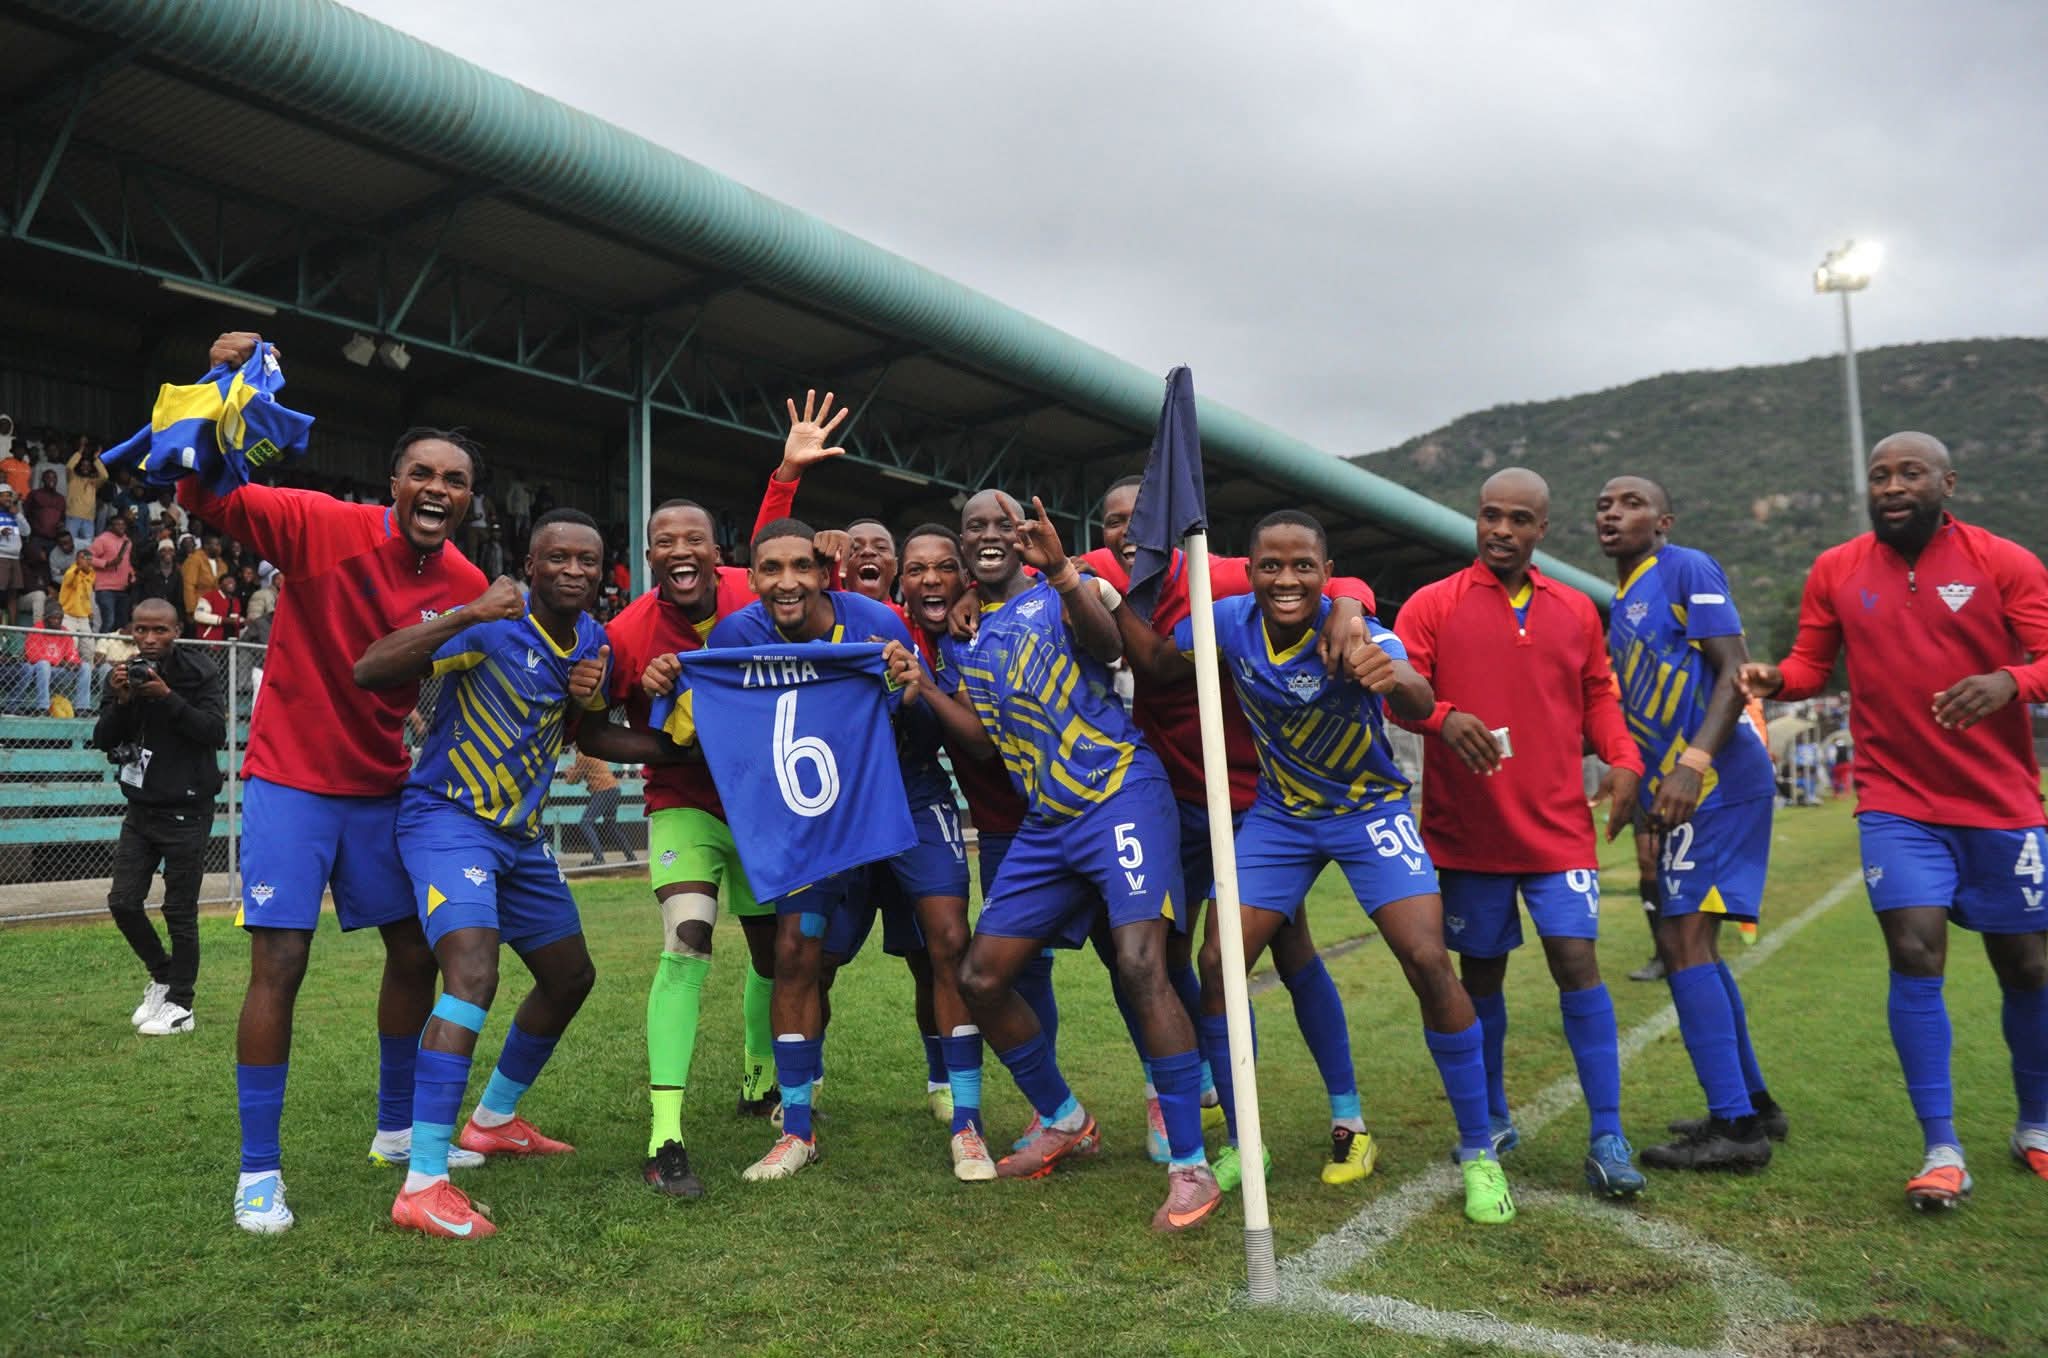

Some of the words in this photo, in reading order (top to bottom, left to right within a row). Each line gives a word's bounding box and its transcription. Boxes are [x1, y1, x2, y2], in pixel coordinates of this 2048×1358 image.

[739, 661, 819, 688] ZITHA
[772, 689, 840, 817] 6
[1114, 822, 1144, 869] 5
[1365, 813, 1425, 857] 50
[2014, 831, 2046, 884] 4
